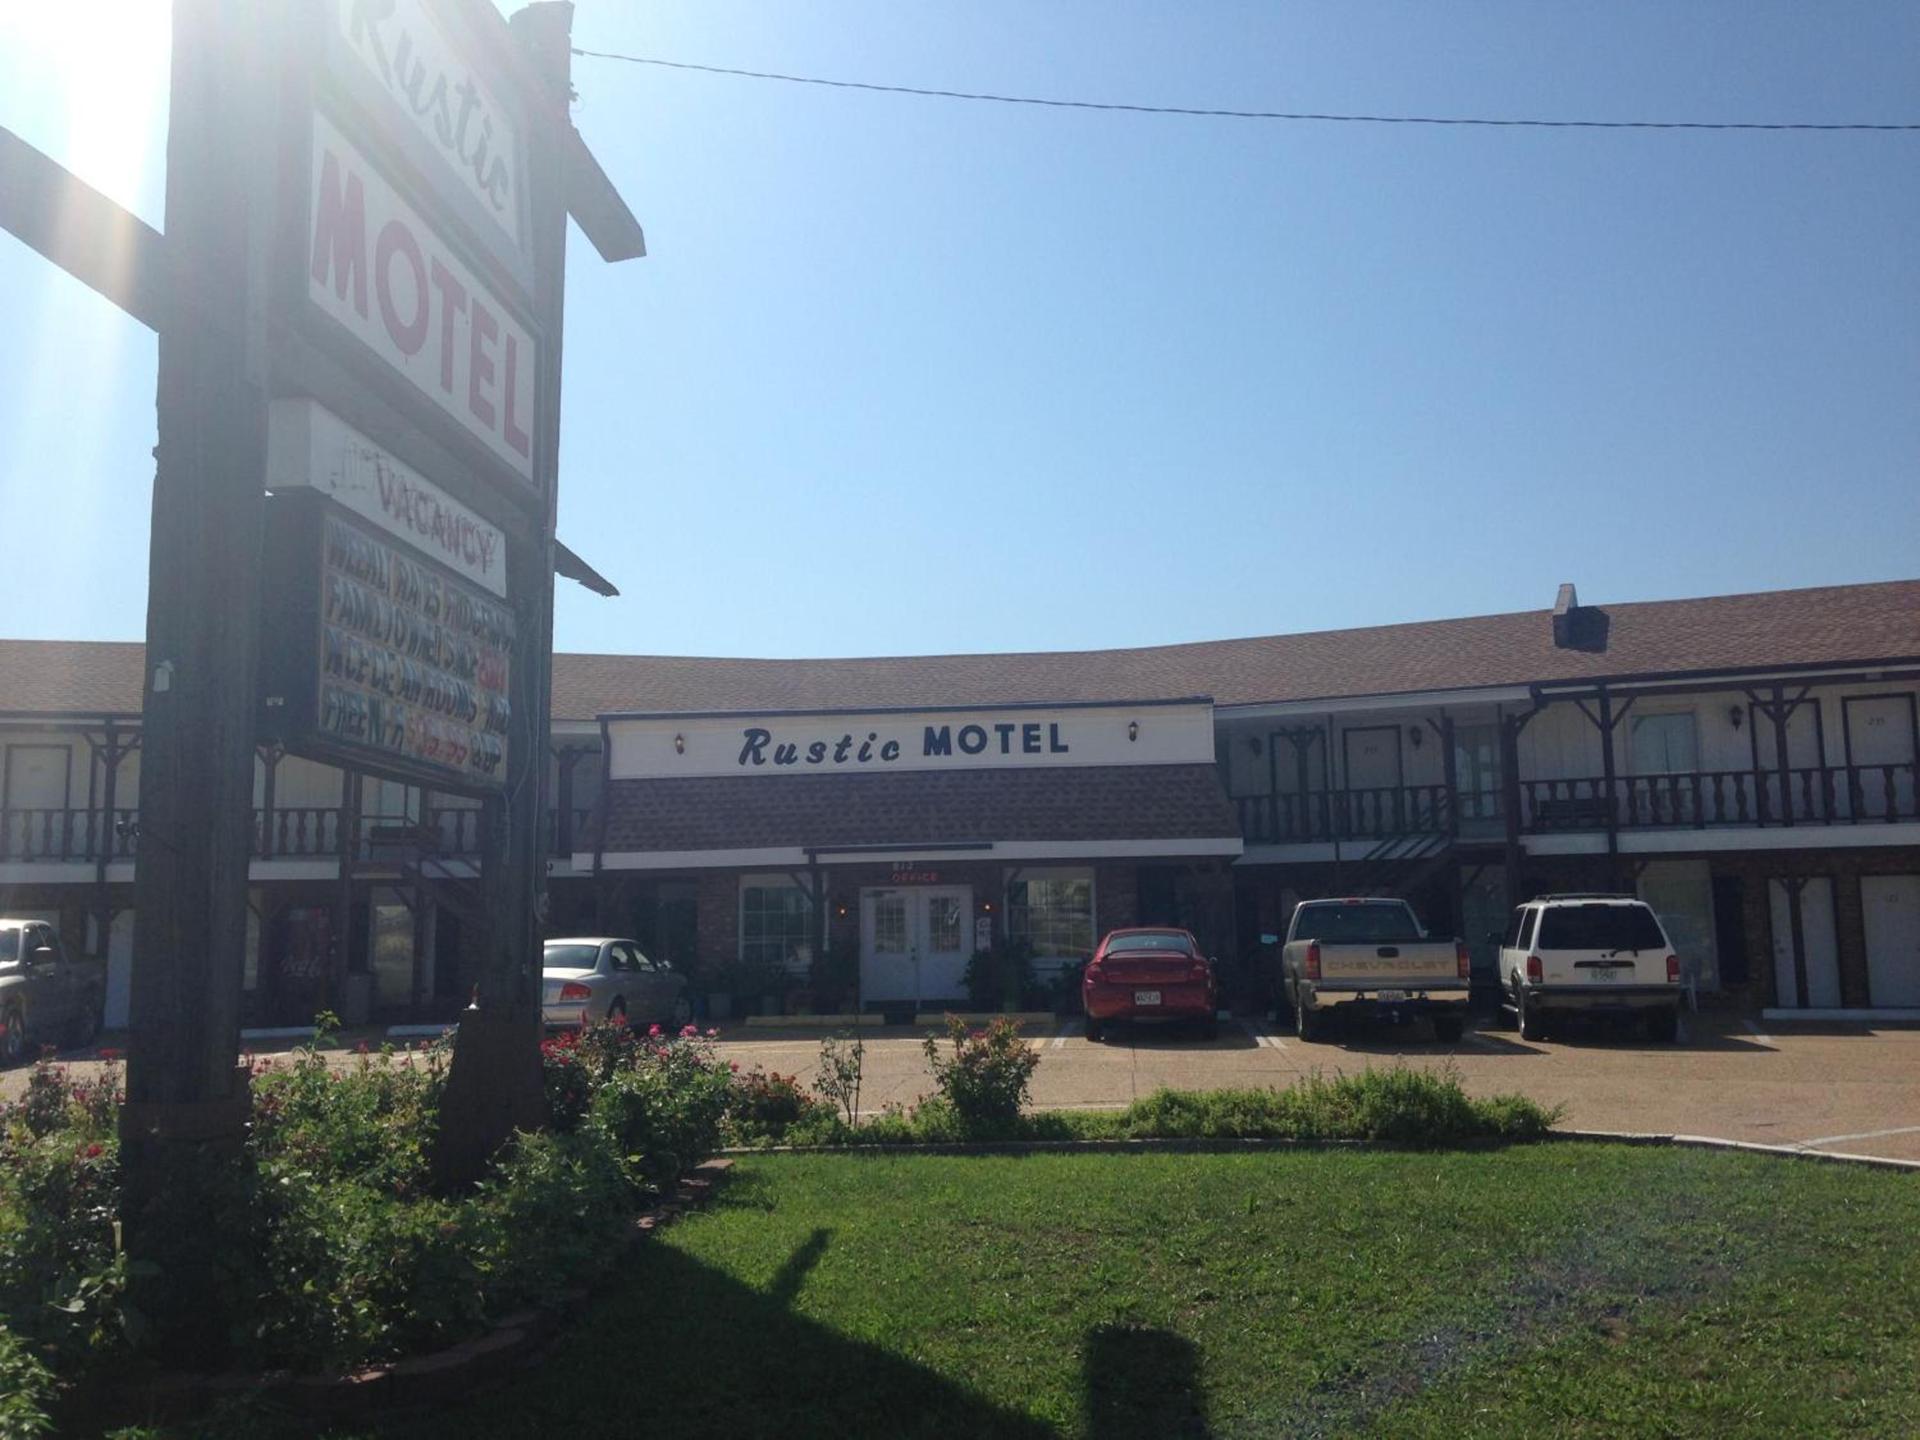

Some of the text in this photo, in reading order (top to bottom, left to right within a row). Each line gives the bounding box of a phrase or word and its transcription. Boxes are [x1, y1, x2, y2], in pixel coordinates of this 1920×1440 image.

[311, 147, 529, 459] MOTEL
[375, 455, 497, 574] VACANCY
[738, 723, 1069, 766] Rustic MOTEL
[891, 872, 940, 882] OFFICE
[1327, 960, 1449, 971] CHEVROLET
